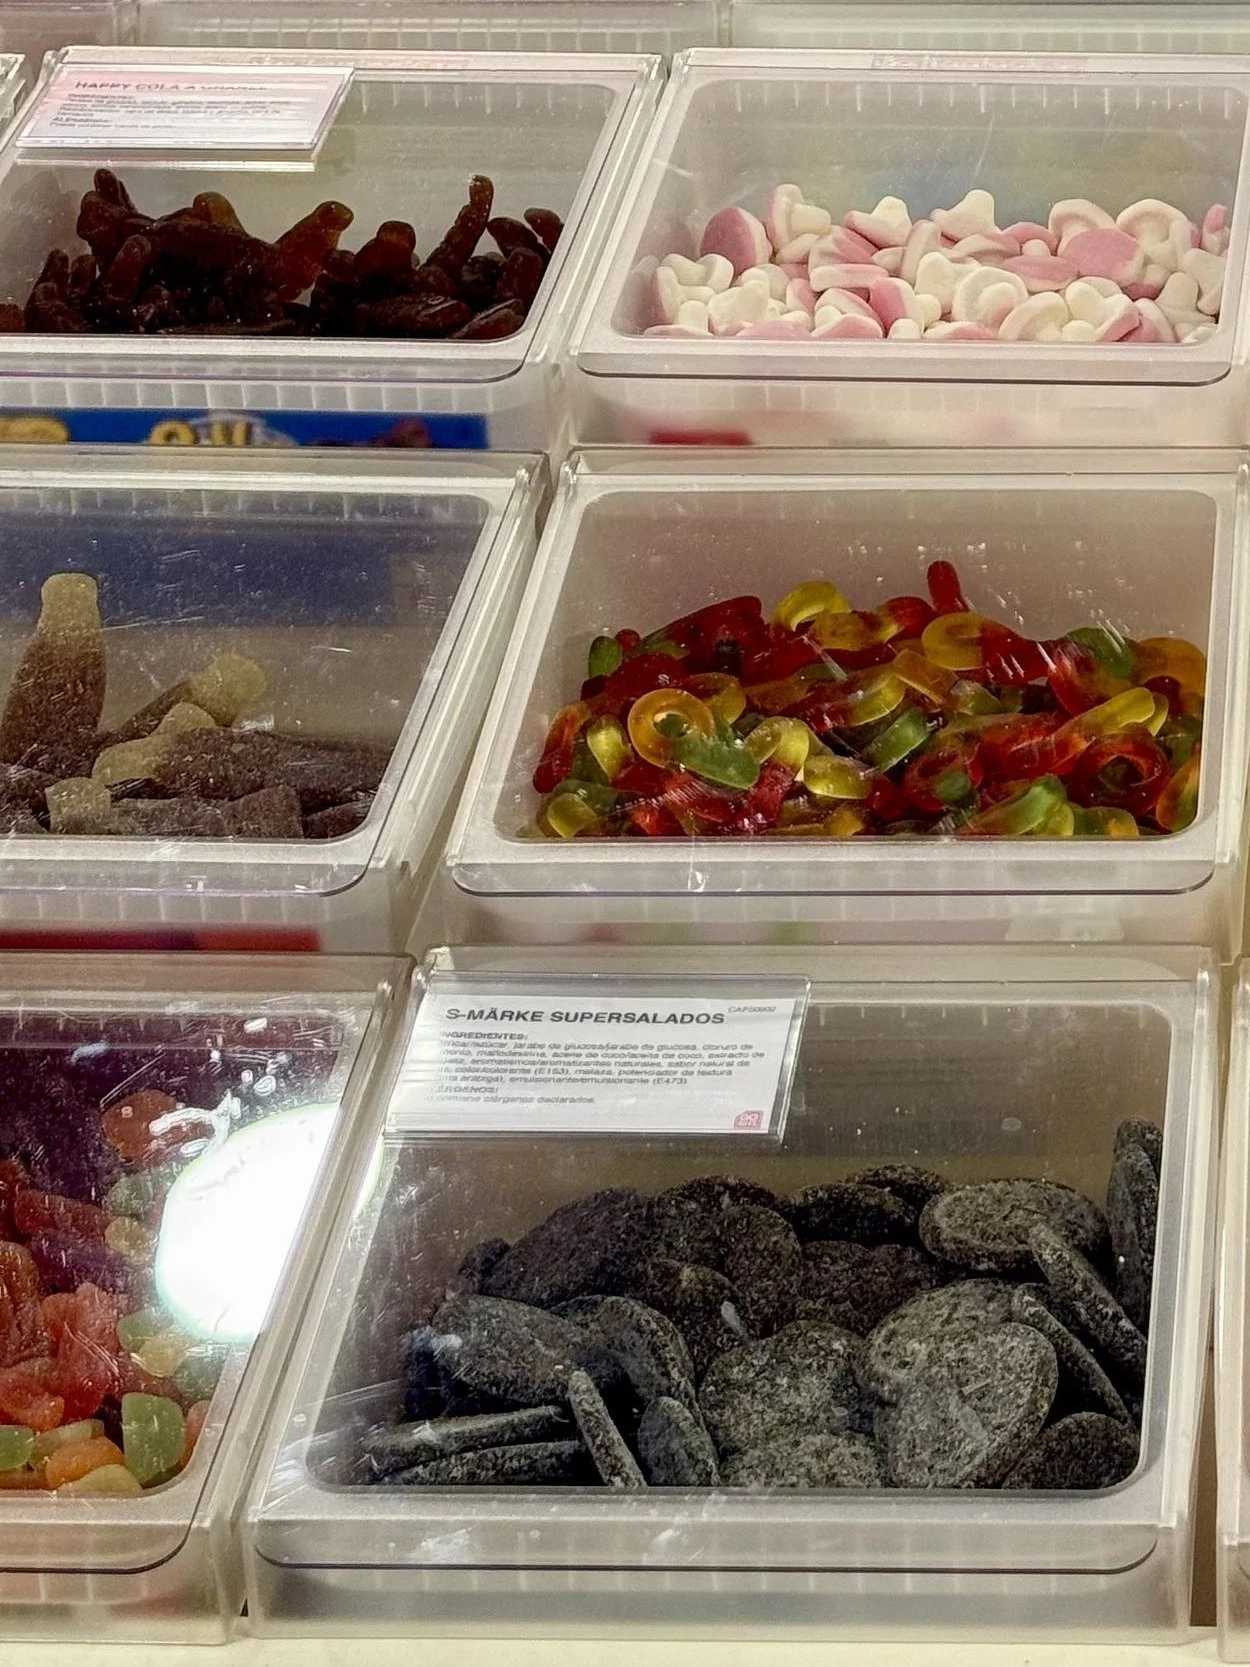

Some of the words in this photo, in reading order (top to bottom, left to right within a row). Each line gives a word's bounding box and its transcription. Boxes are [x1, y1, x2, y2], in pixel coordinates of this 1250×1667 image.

[75, 81, 130, 90] HAPPY
[445, 1007, 545, 1022] S-MÄRKE
[549, 1011, 726, 1024] SUPERSALADOS
